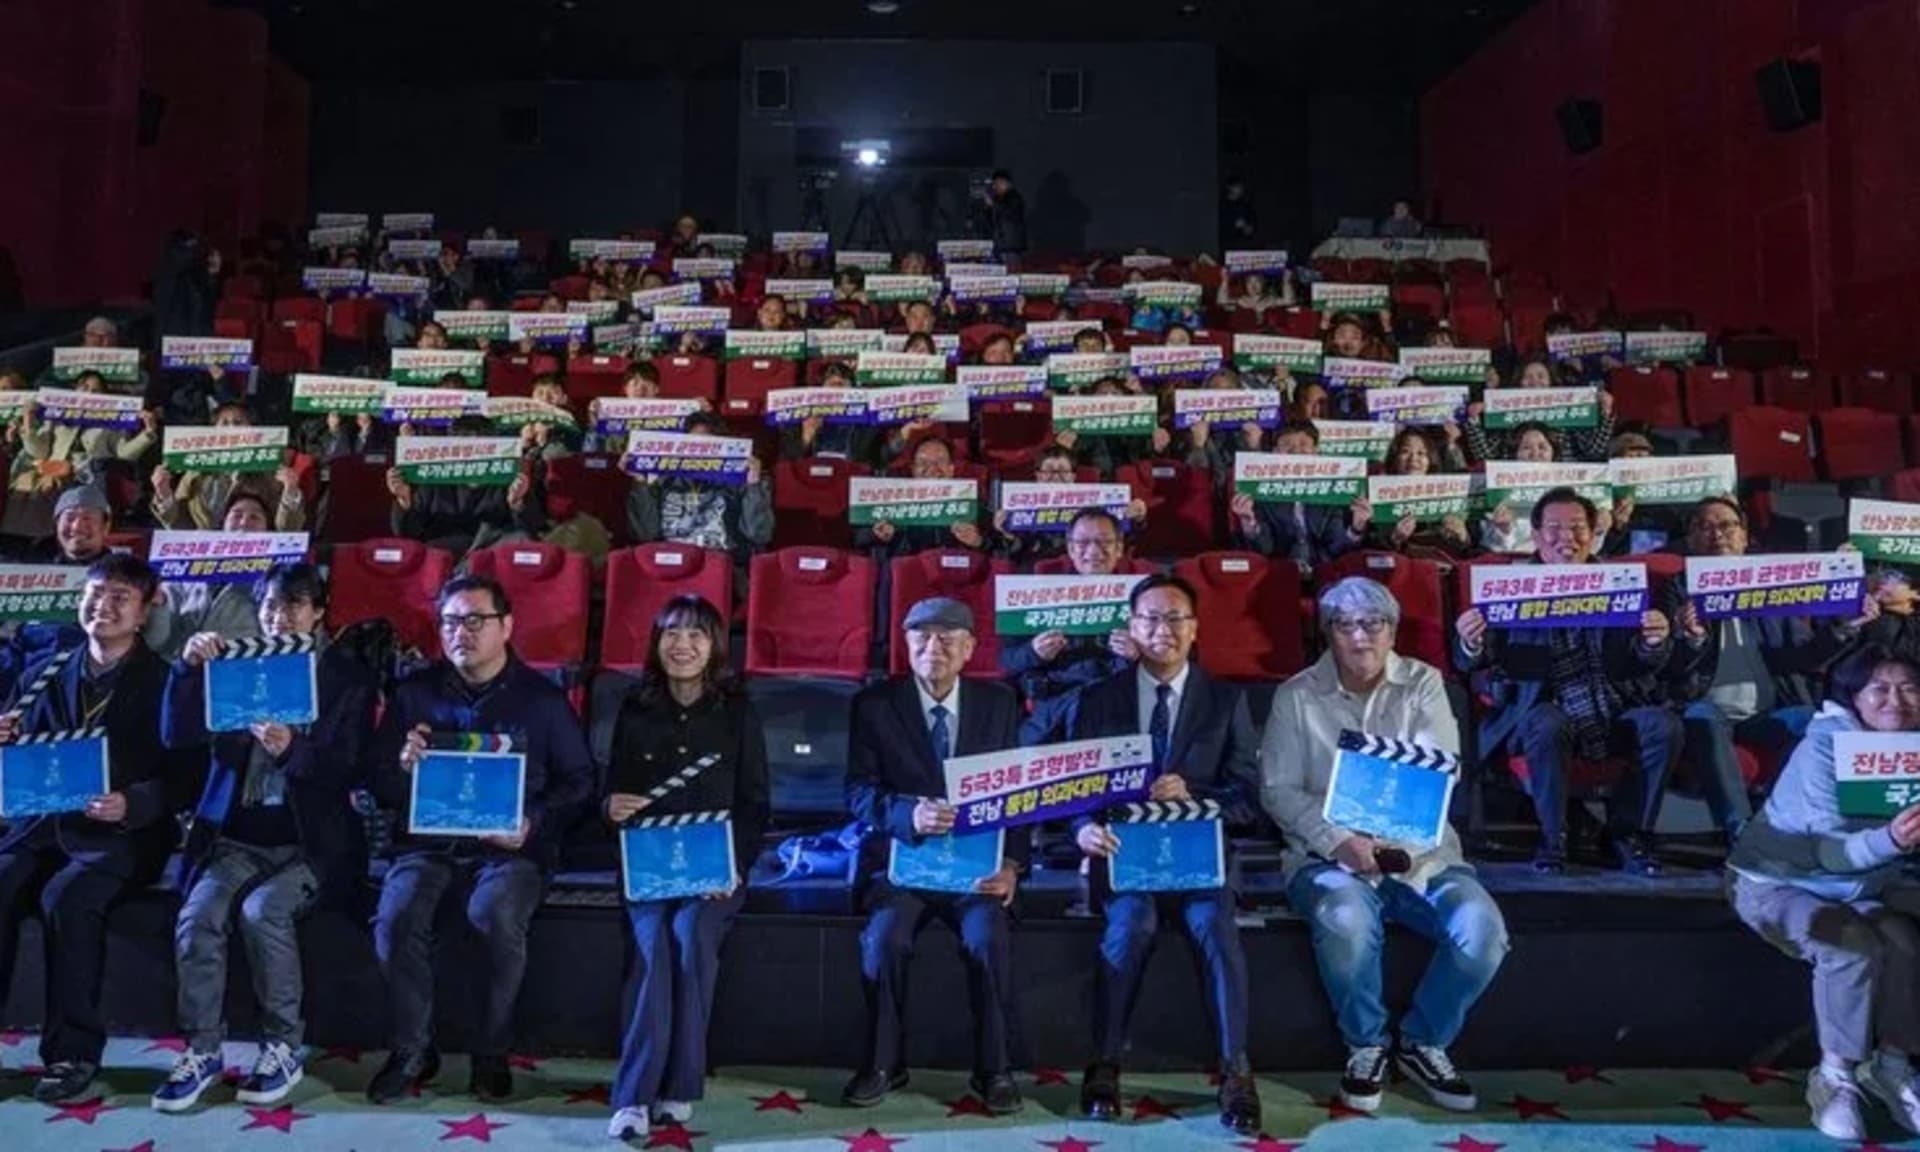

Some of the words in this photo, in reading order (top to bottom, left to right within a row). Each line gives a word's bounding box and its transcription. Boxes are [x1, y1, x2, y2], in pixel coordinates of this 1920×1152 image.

[1481, 577, 1537, 599] 5극3특
[1540, 571, 1605, 594] 균형발전
[1696, 567, 1754, 589] 5극3특
[1756, 560, 1822, 584] 균형발전
[1006, 582, 1127, 606] 전남광주특별시로
[1487, 602, 1517, 622] 전남
[1519, 599, 1550, 620] 통합
[1550, 594, 1611, 616] 의과대학
[1611, 592, 1643, 612] 신설
[1704, 593, 1735, 612] 전남
[1736, 589, 1767, 610] 통합
[1767, 584, 1827, 605] 의과대학
[1828, 581, 1860, 600] 신설
[1024, 605, 1116, 628] 국가균형성장
[958, 764, 1024, 798] 5극3특
[1027, 747, 1103, 781] 균형발전
[968, 796, 1003, 827] 전남
[1005, 789, 1039, 817] 통합
[1039, 772, 1109, 806] 의과대학
[1110, 767, 1147, 793] 신설
